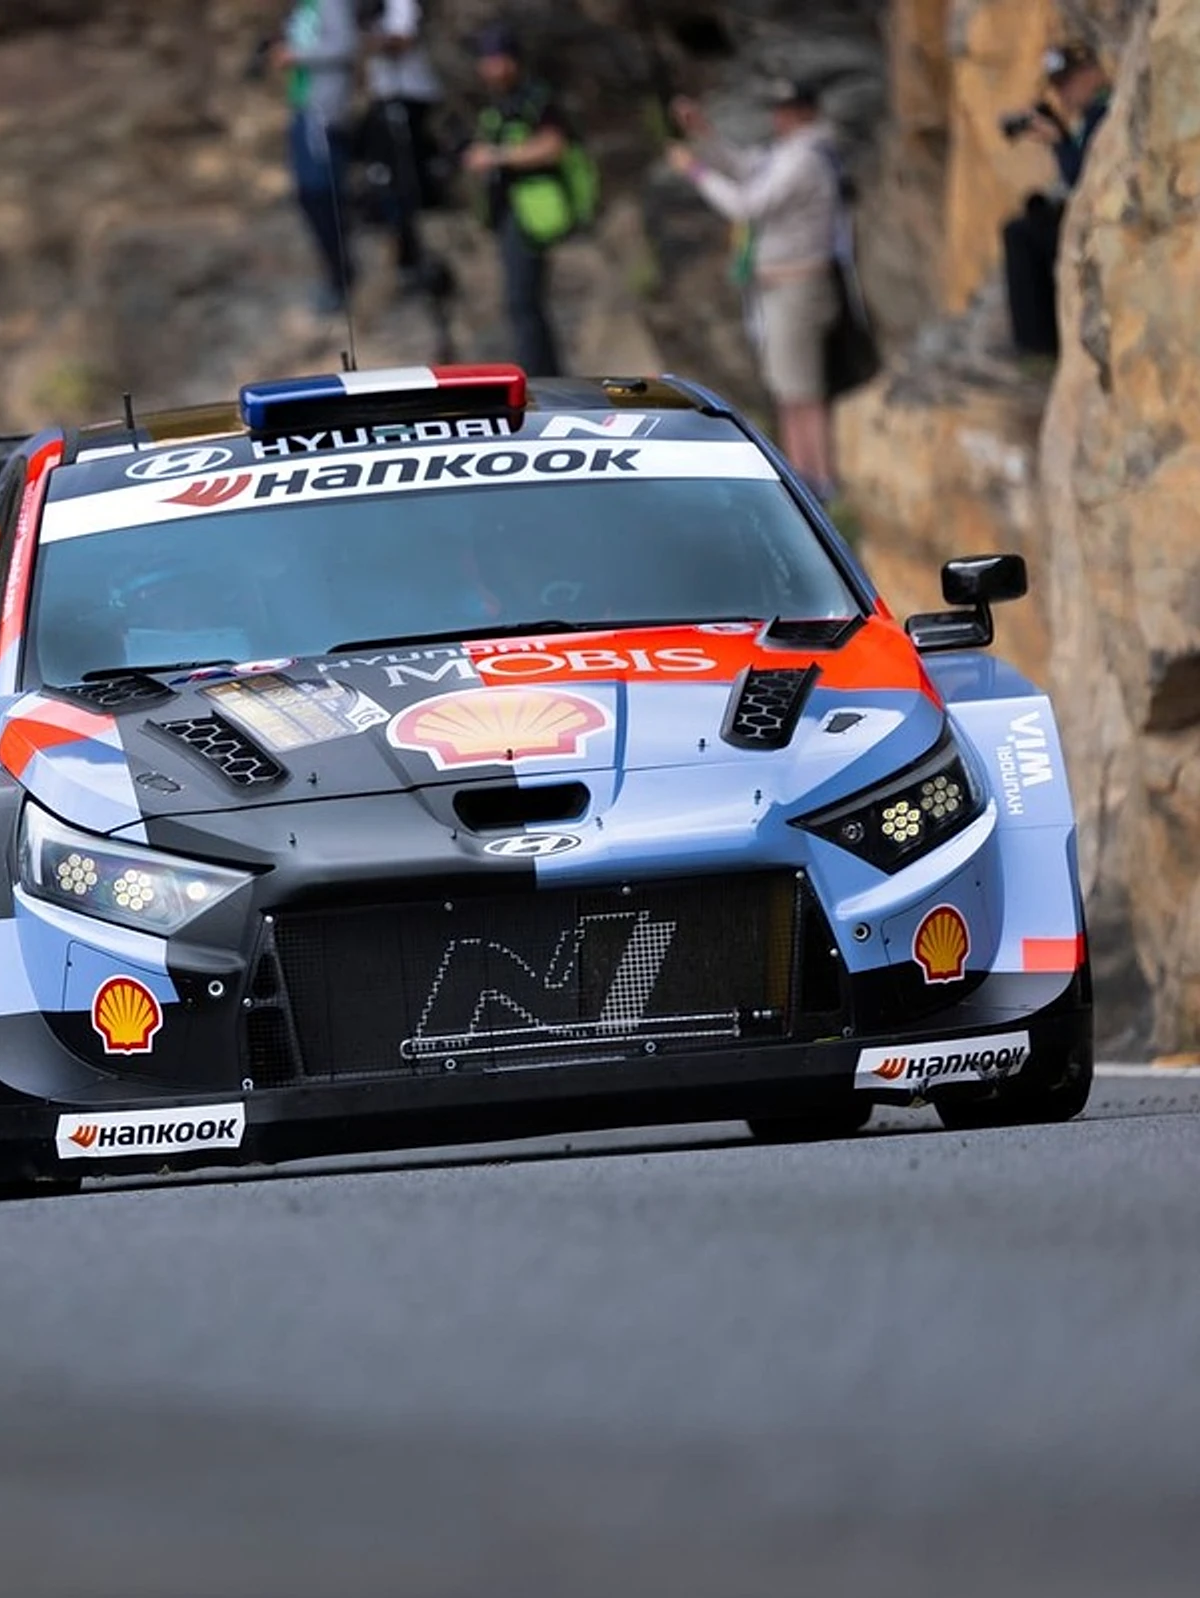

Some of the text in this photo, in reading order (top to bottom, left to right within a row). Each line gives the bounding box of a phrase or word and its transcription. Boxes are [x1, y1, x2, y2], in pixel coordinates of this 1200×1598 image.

[251, 417, 512, 460] HYUNDAI
[316, 641, 548, 673] HYUNDAI
[383, 646, 718, 688] MOBIS
[996, 745, 1024, 816] HYUNDAI
